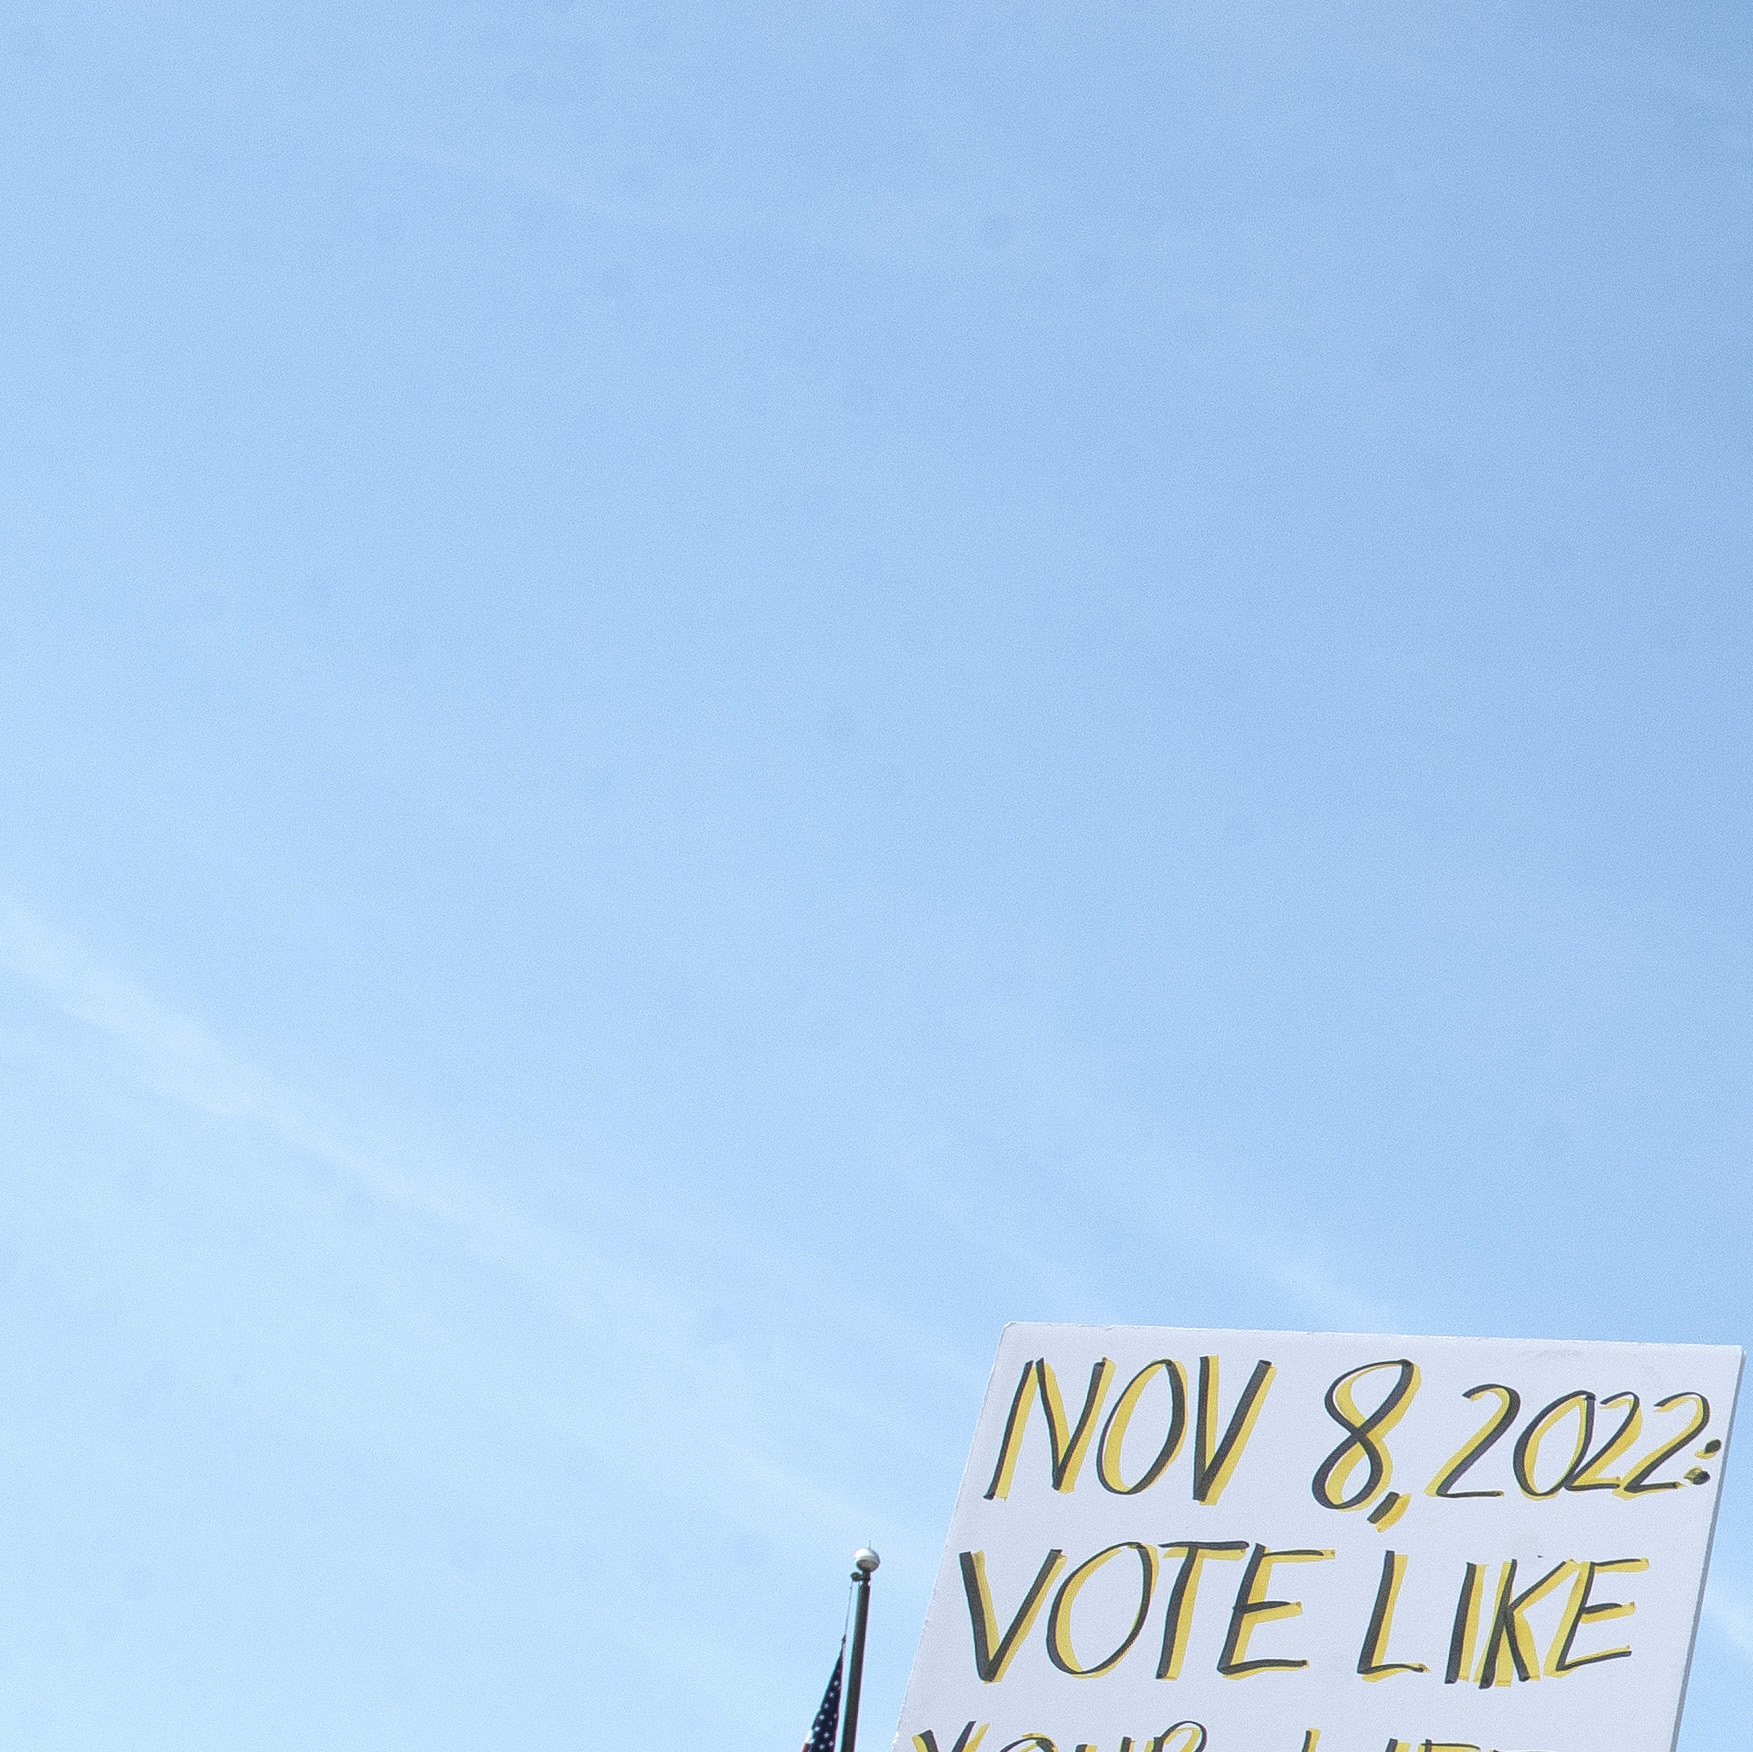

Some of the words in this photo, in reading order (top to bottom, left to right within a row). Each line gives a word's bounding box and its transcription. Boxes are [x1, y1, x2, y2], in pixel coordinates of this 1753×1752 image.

[986, 1358, 1274, 1503] NOV
[960, 1540, 1335, 1682] VOTE
[1356, 1549, 1649, 1689] LIKE
